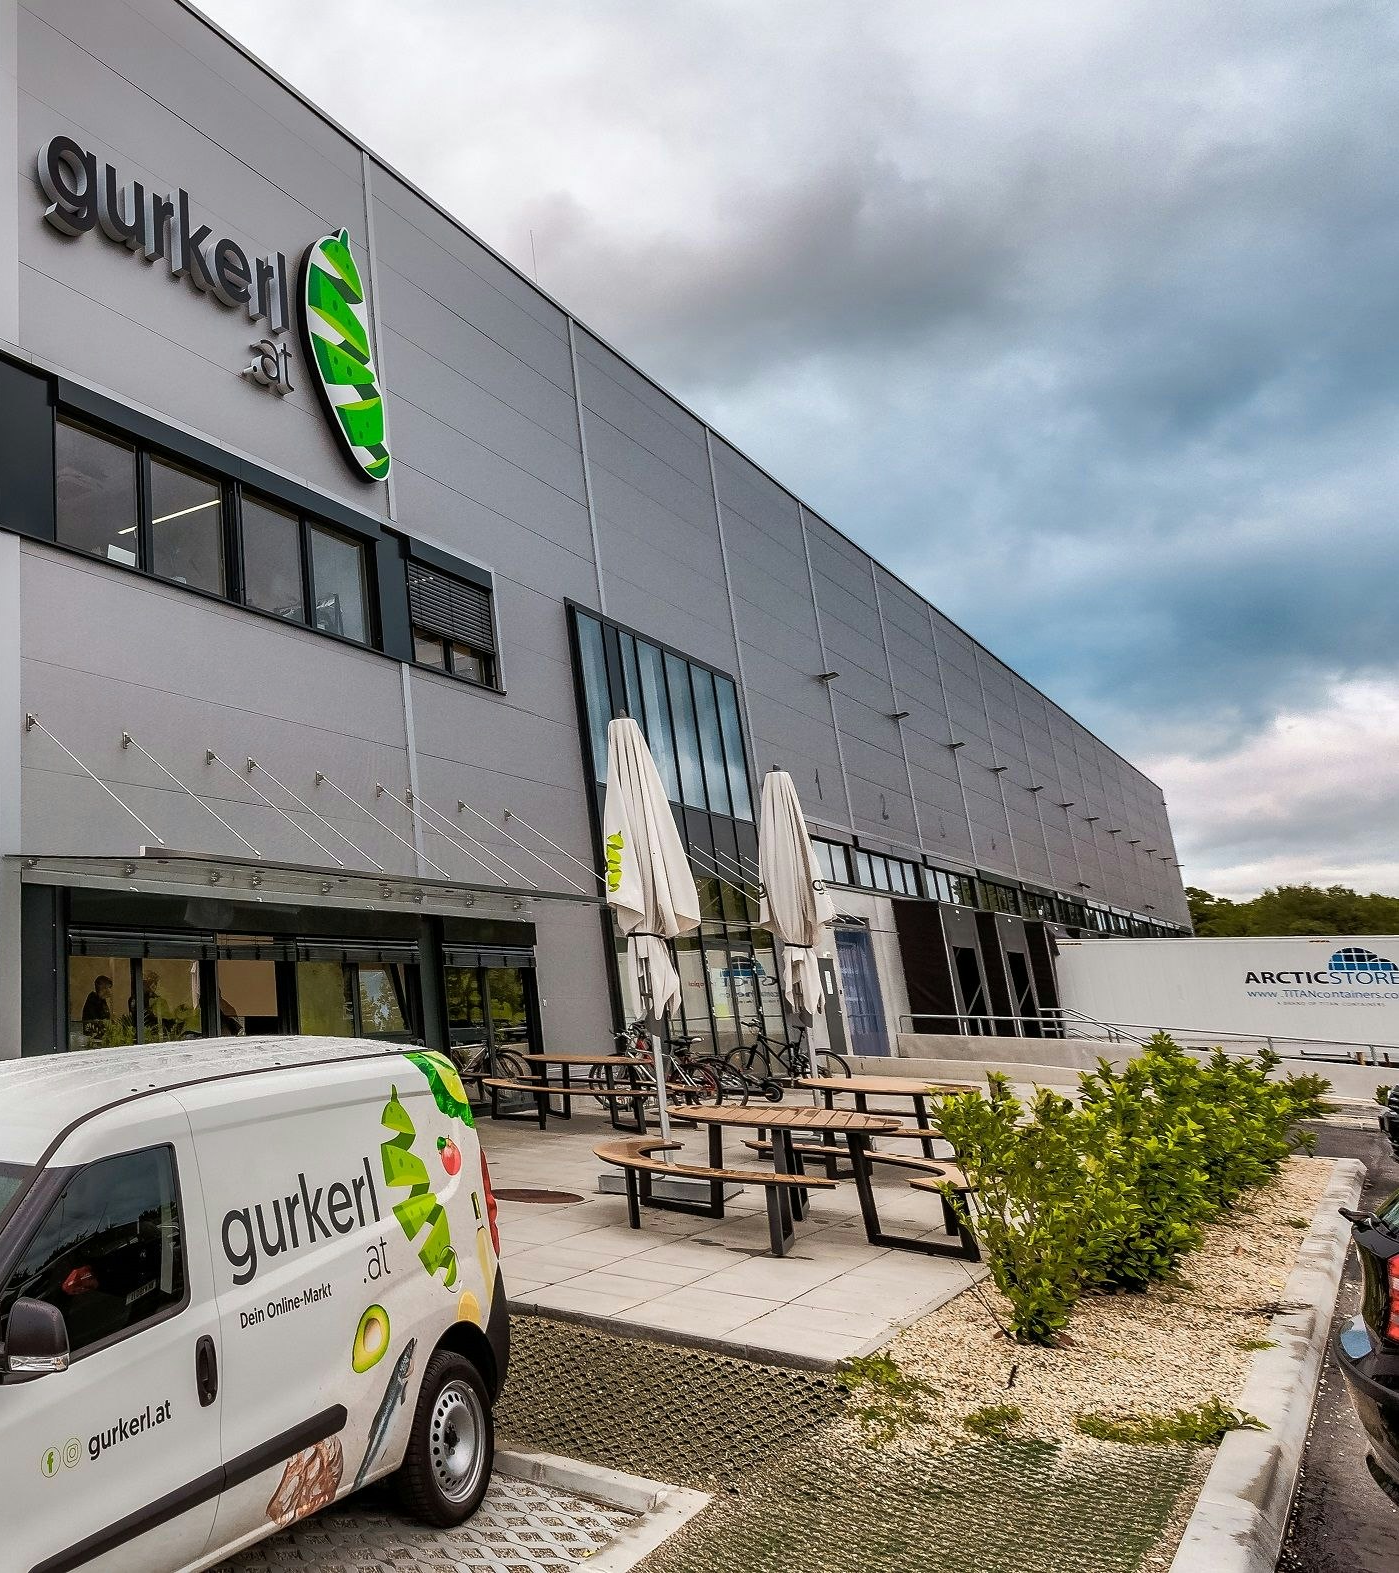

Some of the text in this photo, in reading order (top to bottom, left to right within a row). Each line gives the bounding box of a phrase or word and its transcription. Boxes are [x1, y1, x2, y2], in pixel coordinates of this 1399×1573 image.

[38, 135, 289, 333] gurkerl
[243, 340, 294, 396] .at
[1245, 971, 1399, 985] ARCTICSTORE
[222, 1157, 381, 1285] gurkerl
[363, 1236, 391, 1284] .at
[239, 1282, 332, 1330] Dein Online-Markt
[88, 1399, 172, 1461] gurkerl.at
